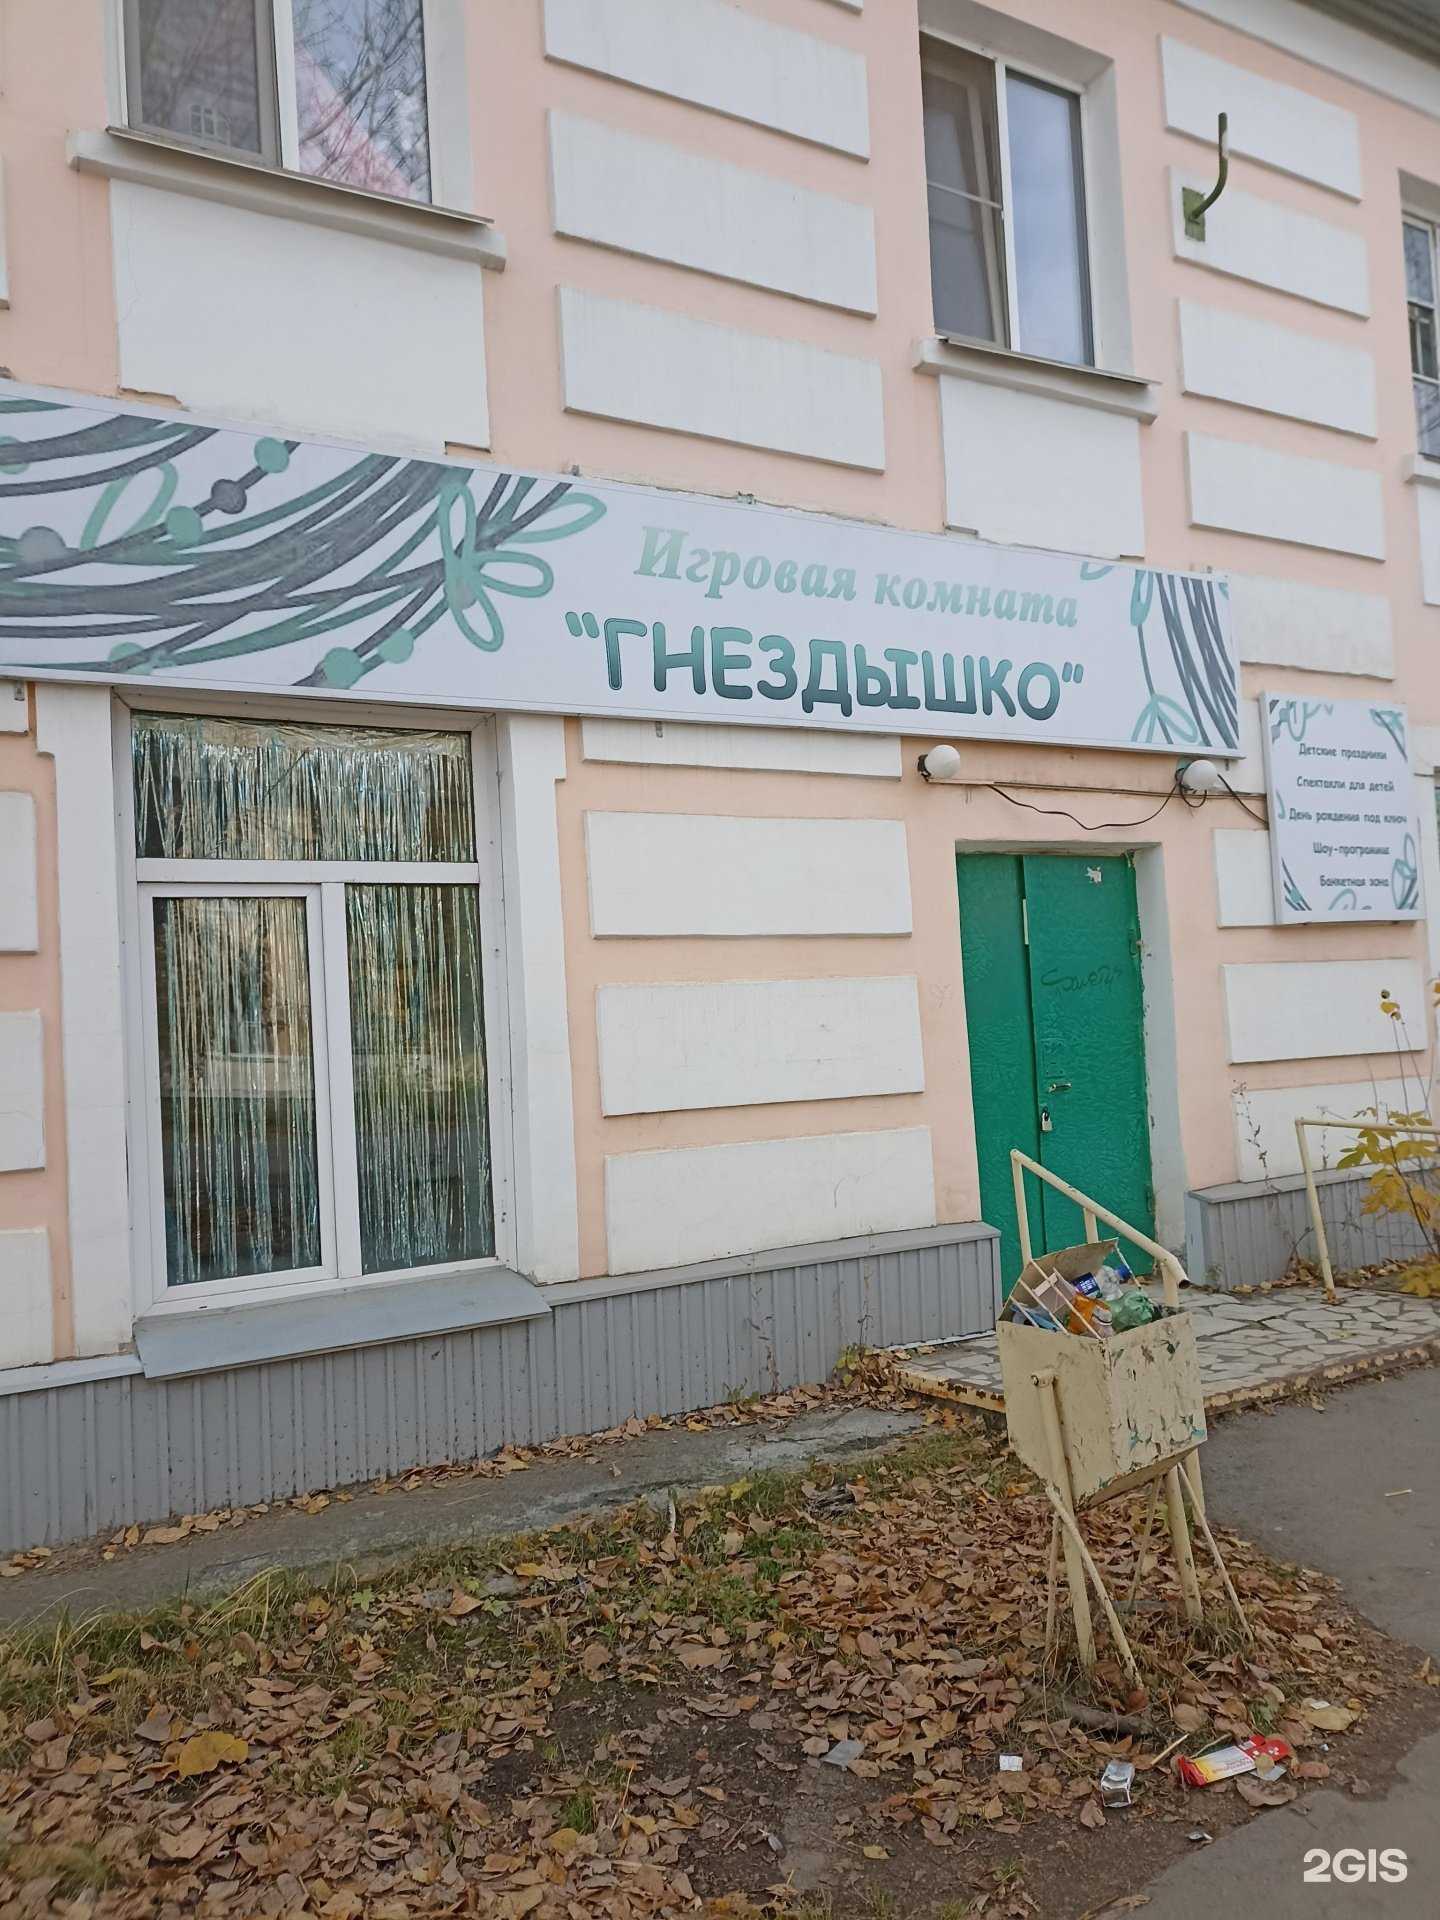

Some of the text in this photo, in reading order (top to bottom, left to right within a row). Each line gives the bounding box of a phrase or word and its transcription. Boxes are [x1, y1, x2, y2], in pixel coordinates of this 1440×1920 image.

[633, 525, 1080, 629] Игровая комната
[564, 611, 1085, 722] "ГНЕЗДЫШКО"
[1299, 743, 1388, 761] Детские праздники
[1296, 775, 1395, 792] Спектакли для детей
[1289, 807, 1407, 825] День рождения под ключ
[1319, 874, 1389, 888] Банкетная зона
